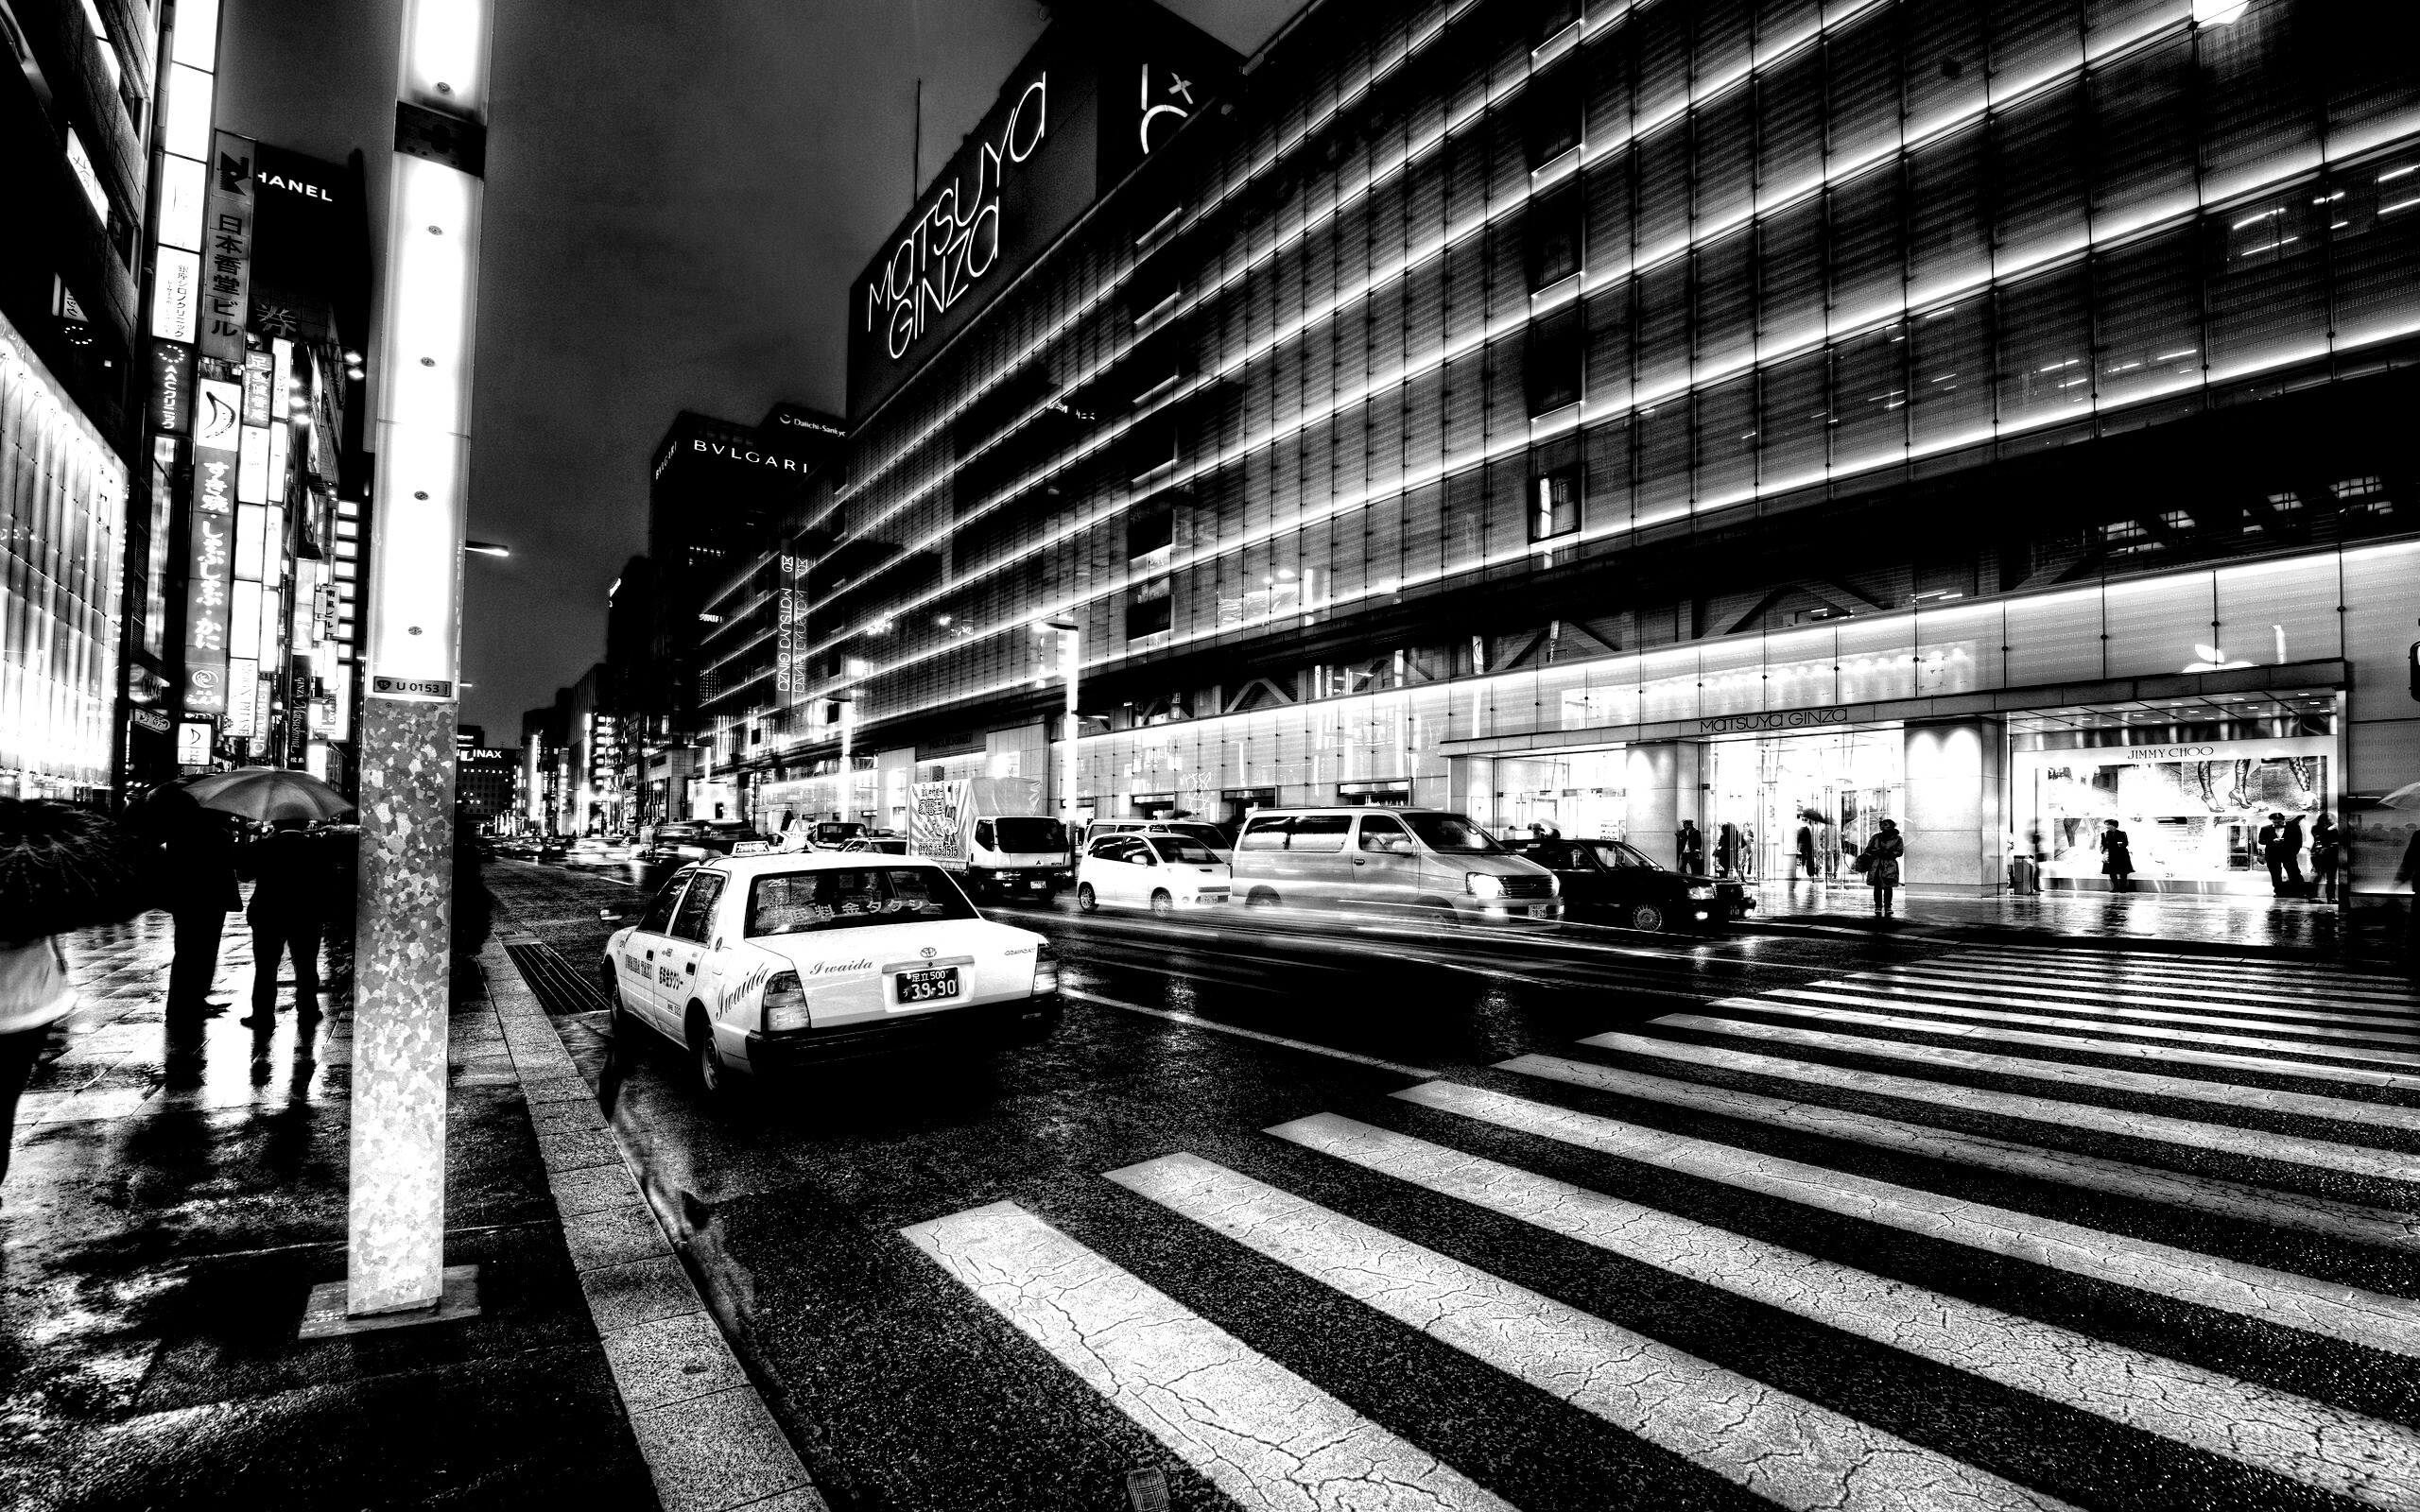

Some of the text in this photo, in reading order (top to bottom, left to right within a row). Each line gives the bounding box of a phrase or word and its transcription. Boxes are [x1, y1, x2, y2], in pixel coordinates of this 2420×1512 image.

[257, 171, 333, 202] HANEL
[211, 214, 243, 336] 日本香堂ビル
[693, 438, 807, 473] BVLGARI
[396, 681, 406, 691] U
[409, 682, 440, 694] 0153
[473, 749, 502, 759] INAX
[2127, 746, 2214, 760] JIMMY CHOO
[809, 957, 874, 975] Iwaida
[929, 970, 946, 980] 500
[716, 962, 770, 1021] Iwaida
[910, 979, 957, 1000] 39-90
